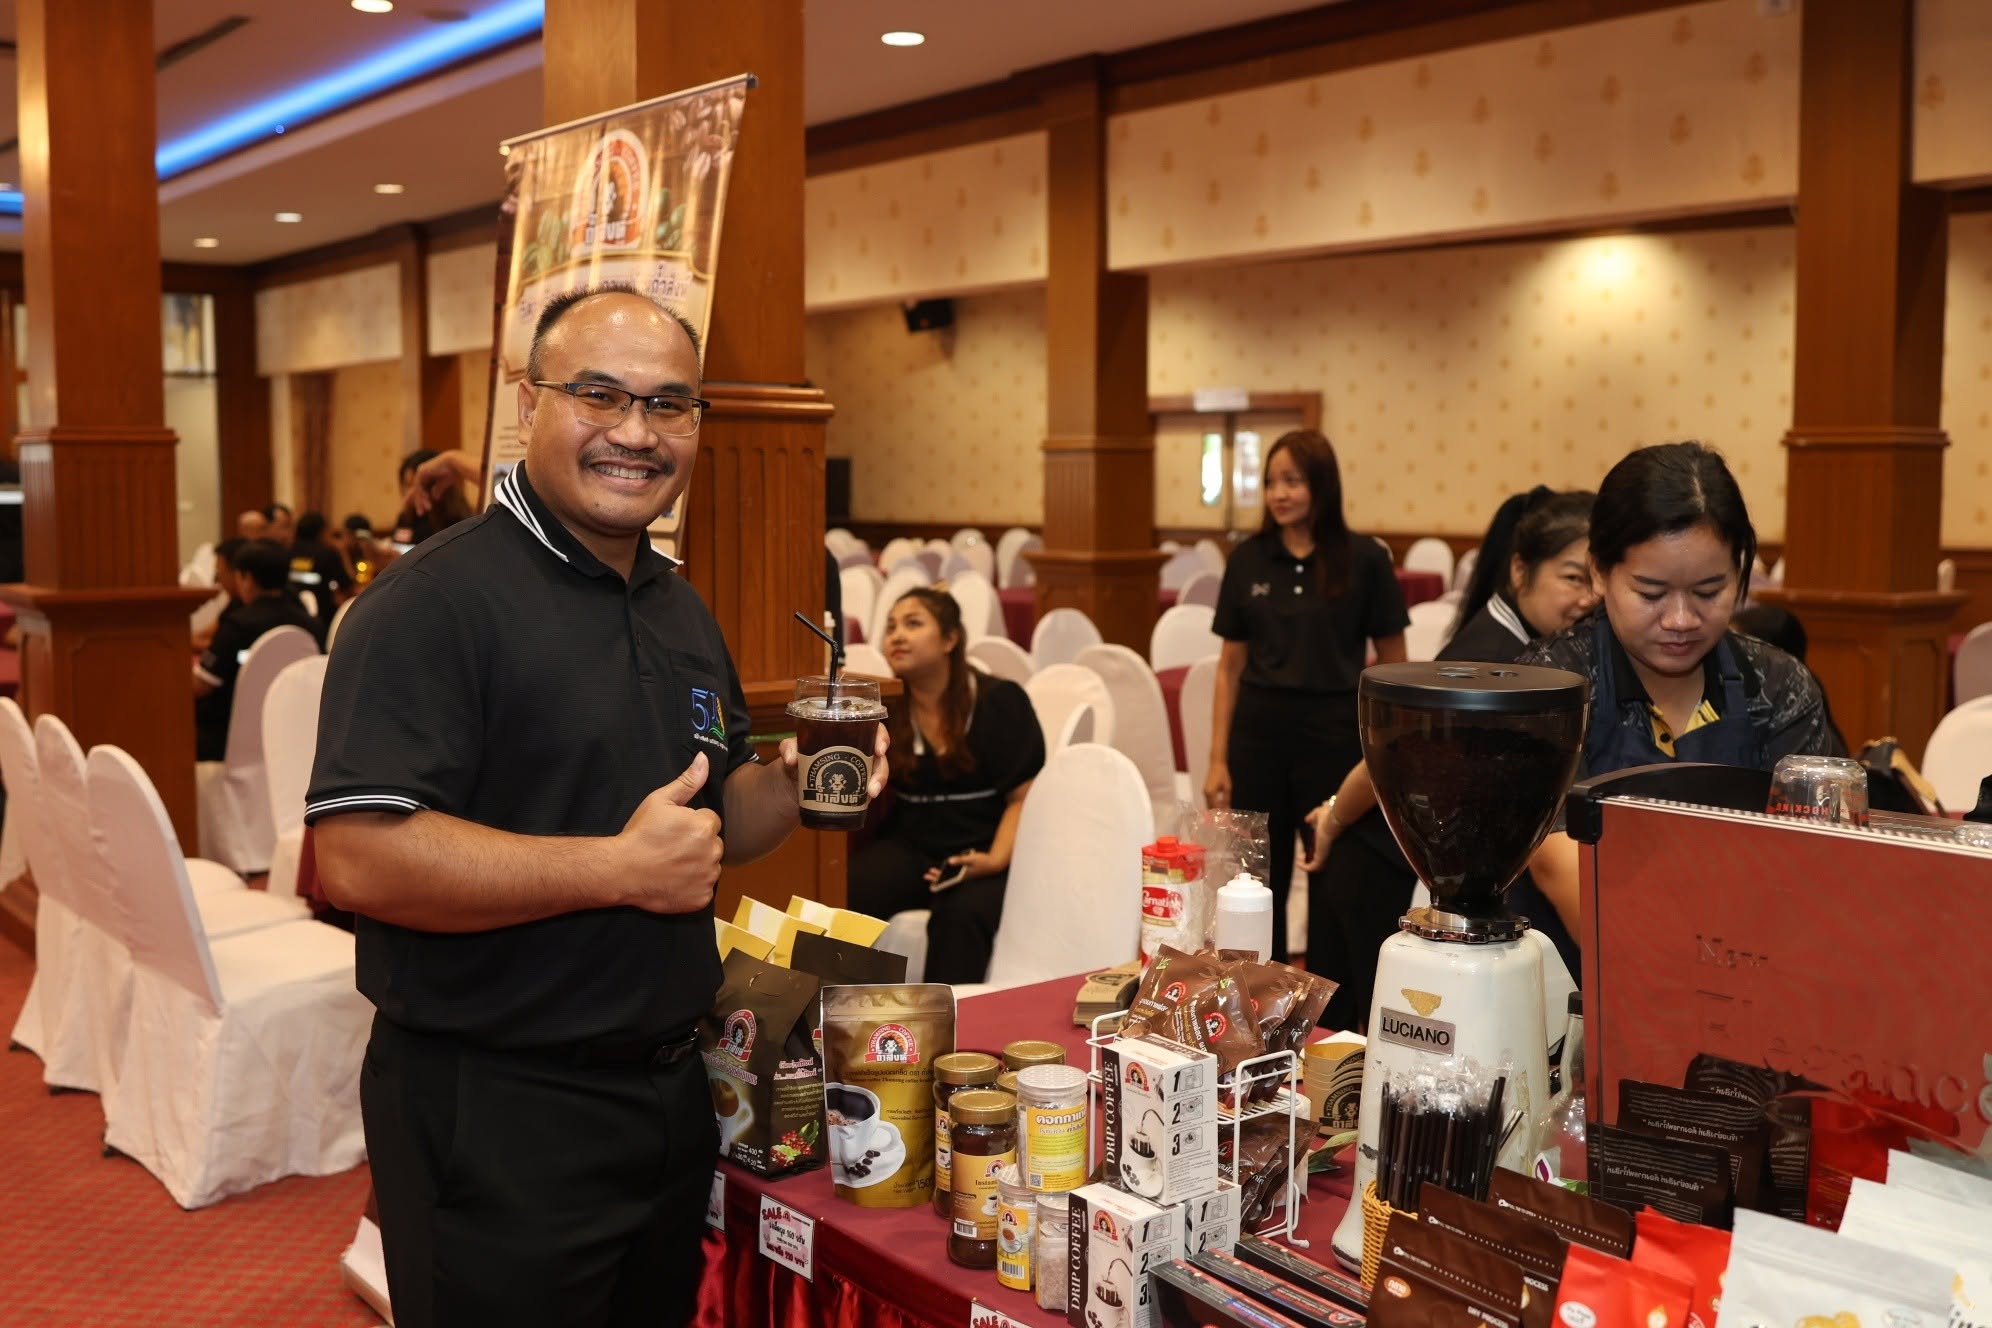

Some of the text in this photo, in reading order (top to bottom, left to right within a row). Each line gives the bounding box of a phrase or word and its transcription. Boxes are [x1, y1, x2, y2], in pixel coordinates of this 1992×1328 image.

[809, 753, 840, 782] THAMSING
[870, 1026, 891, 1048] THAMSING
[1382, 1016, 1450, 1046] LUCIANO
[1173, 1070, 1181, 1092] 1
[1104, 1061, 1116, 1164] DRIP COFFEE
[1172, 1102, 1181, 1125] 2
[1172, 1133, 1181, 1156] 3
[762, 1207, 782, 1220] SALE
[1200, 1201, 1208, 1222] 1
[1142, 1221, 1150, 1243] 1
[1199, 1231, 1206, 1253] 2
[1070, 1206, 1081, 1310] DRIP COFFEE
[1139, 1252, 1149, 1276] 2
[1139, 1283, 1149, 1306] 3
[973, 1315, 998, 1328] SALE
